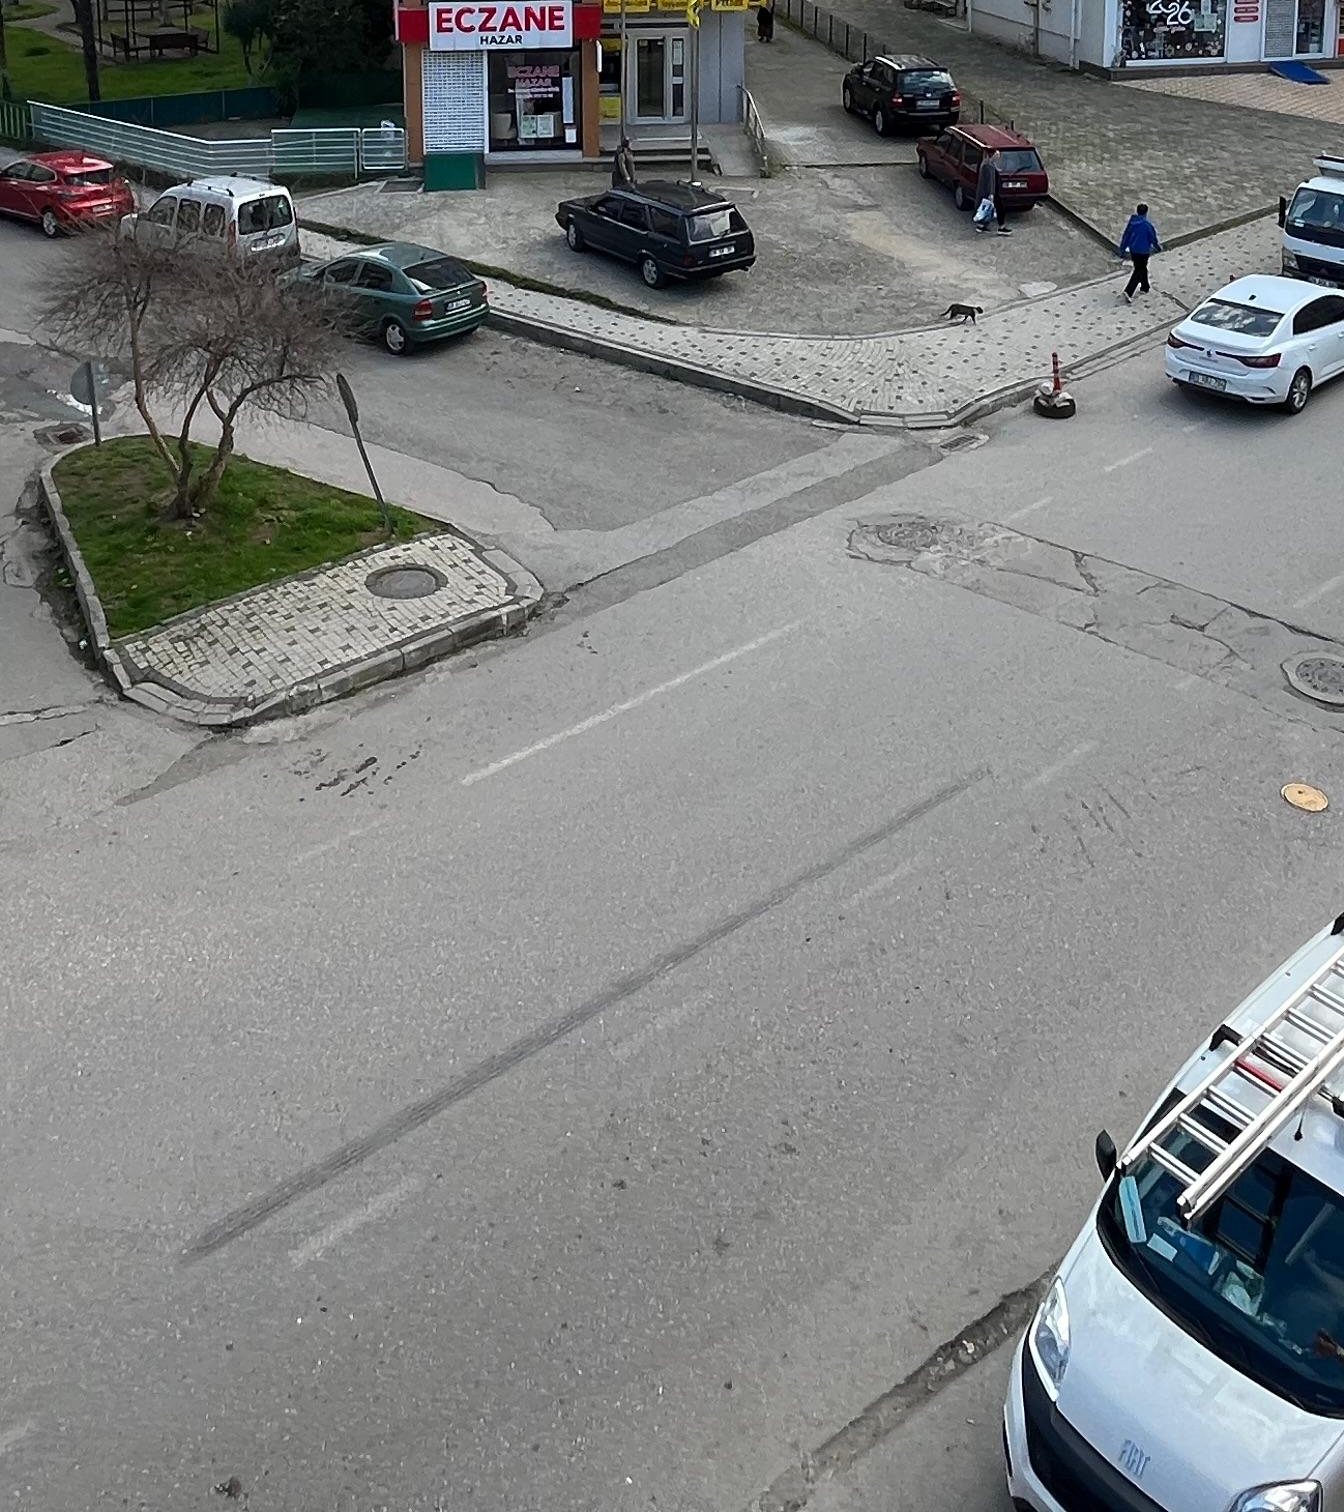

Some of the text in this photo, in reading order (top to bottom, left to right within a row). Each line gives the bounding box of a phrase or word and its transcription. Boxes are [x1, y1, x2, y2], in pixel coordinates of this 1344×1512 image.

[436, 5, 565, 33] ECZANE
[479, 35, 523, 45] HAZAR
[1118, 1438, 1152, 1479] FIAT
